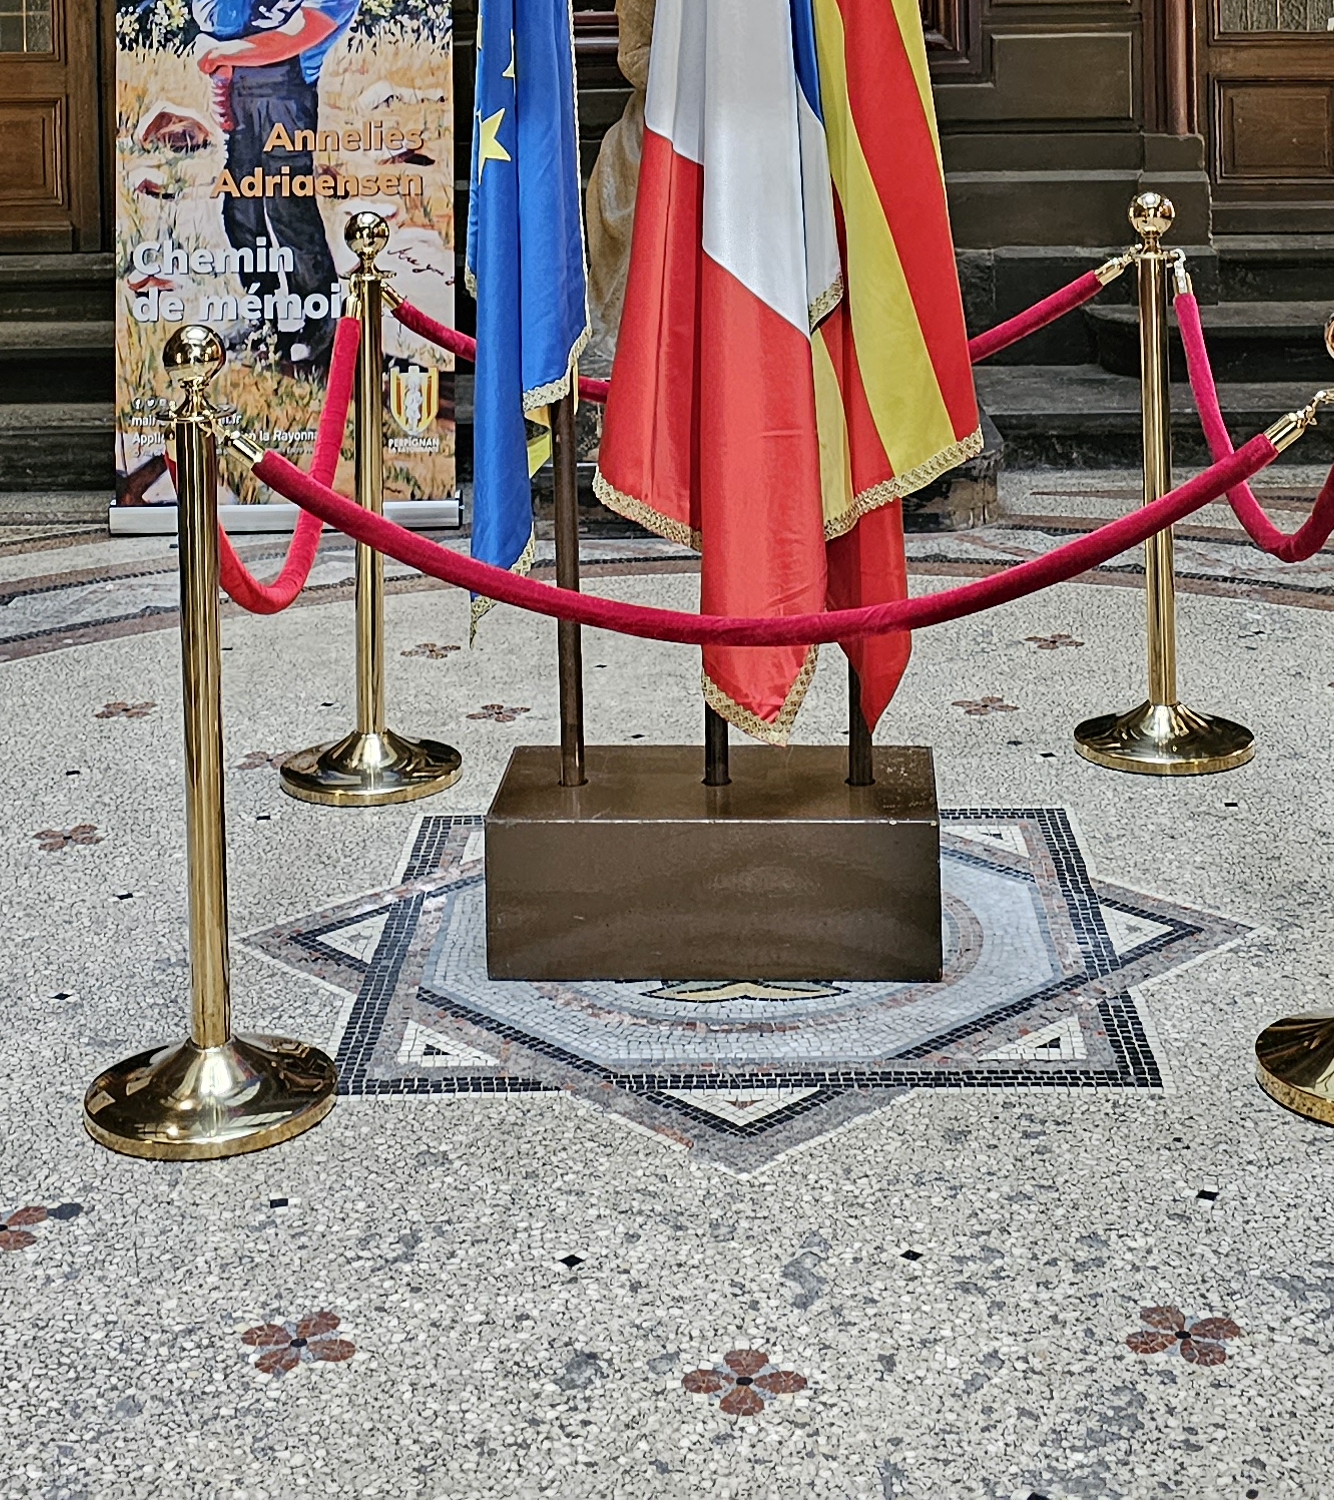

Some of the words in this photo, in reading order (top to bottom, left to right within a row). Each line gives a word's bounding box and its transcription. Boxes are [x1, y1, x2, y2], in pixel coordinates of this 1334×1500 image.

[263, 122, 424, 152] Annelies
[210, 168, 423, 199] Adriaensen
[133, 237, 295, 275] Chemin
[132, 288, 185, 322] de
[201, 283, 342, 320] mémoi
